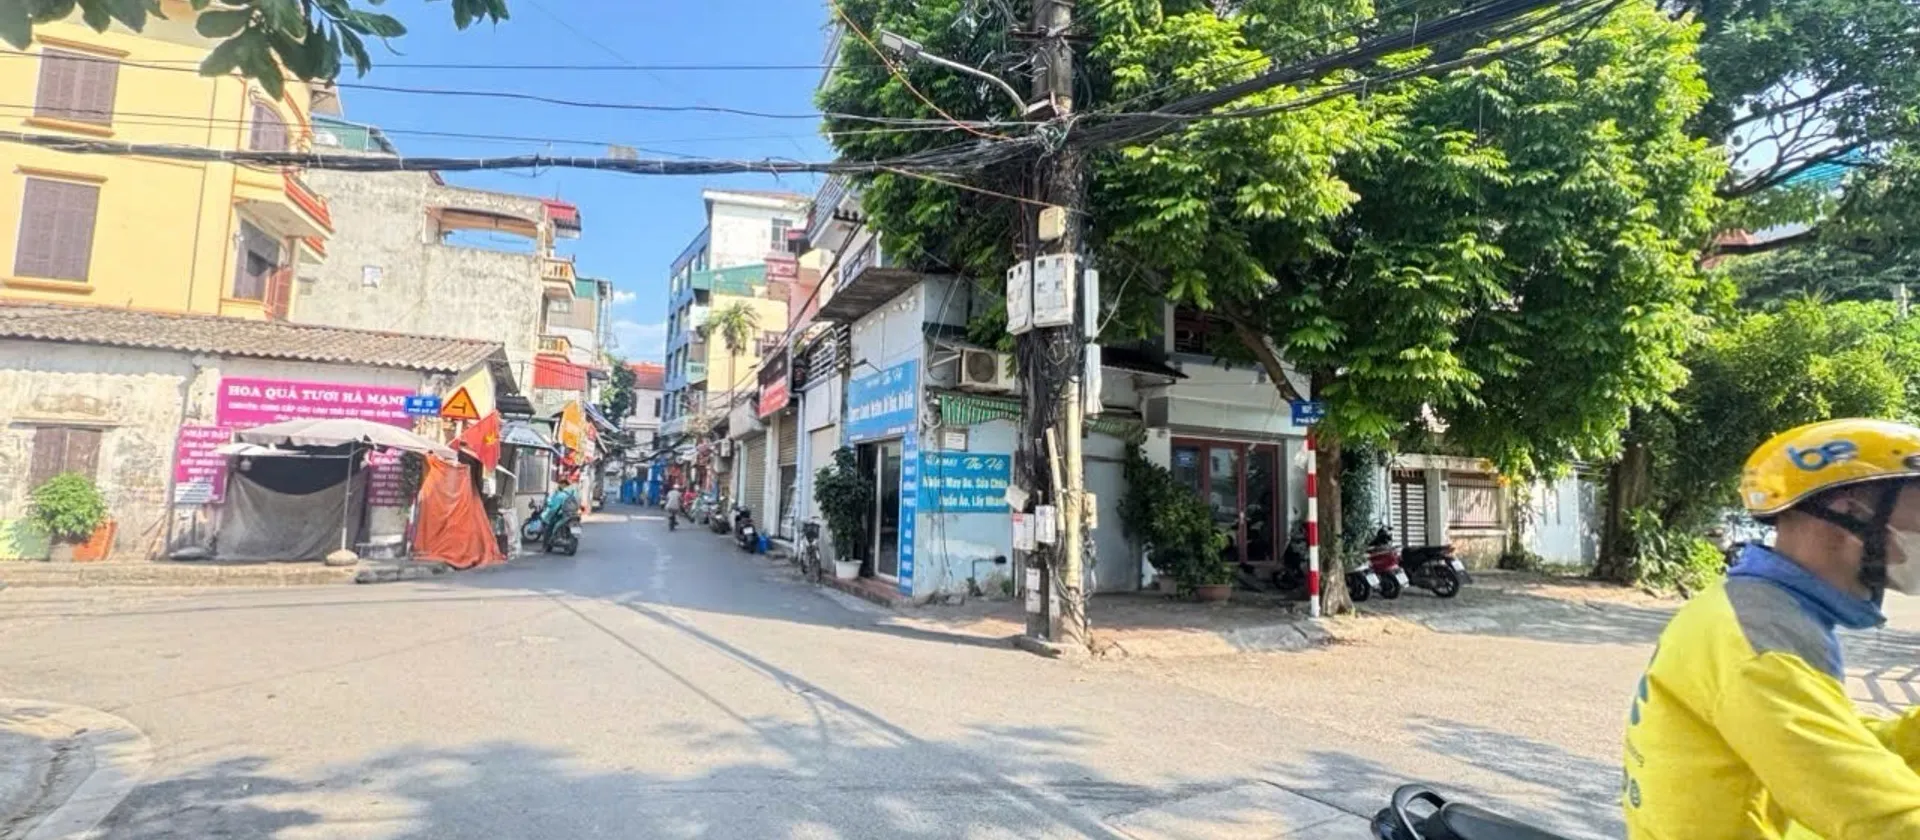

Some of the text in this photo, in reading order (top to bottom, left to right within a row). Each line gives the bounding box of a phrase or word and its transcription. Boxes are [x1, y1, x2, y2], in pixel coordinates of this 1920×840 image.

[228, 385, 261, 397] HOA
[302, 389, 339, 402] TƯƠI
[342, 390, 363, 403] HÀ
[1787, 441, 1857, 470] be
